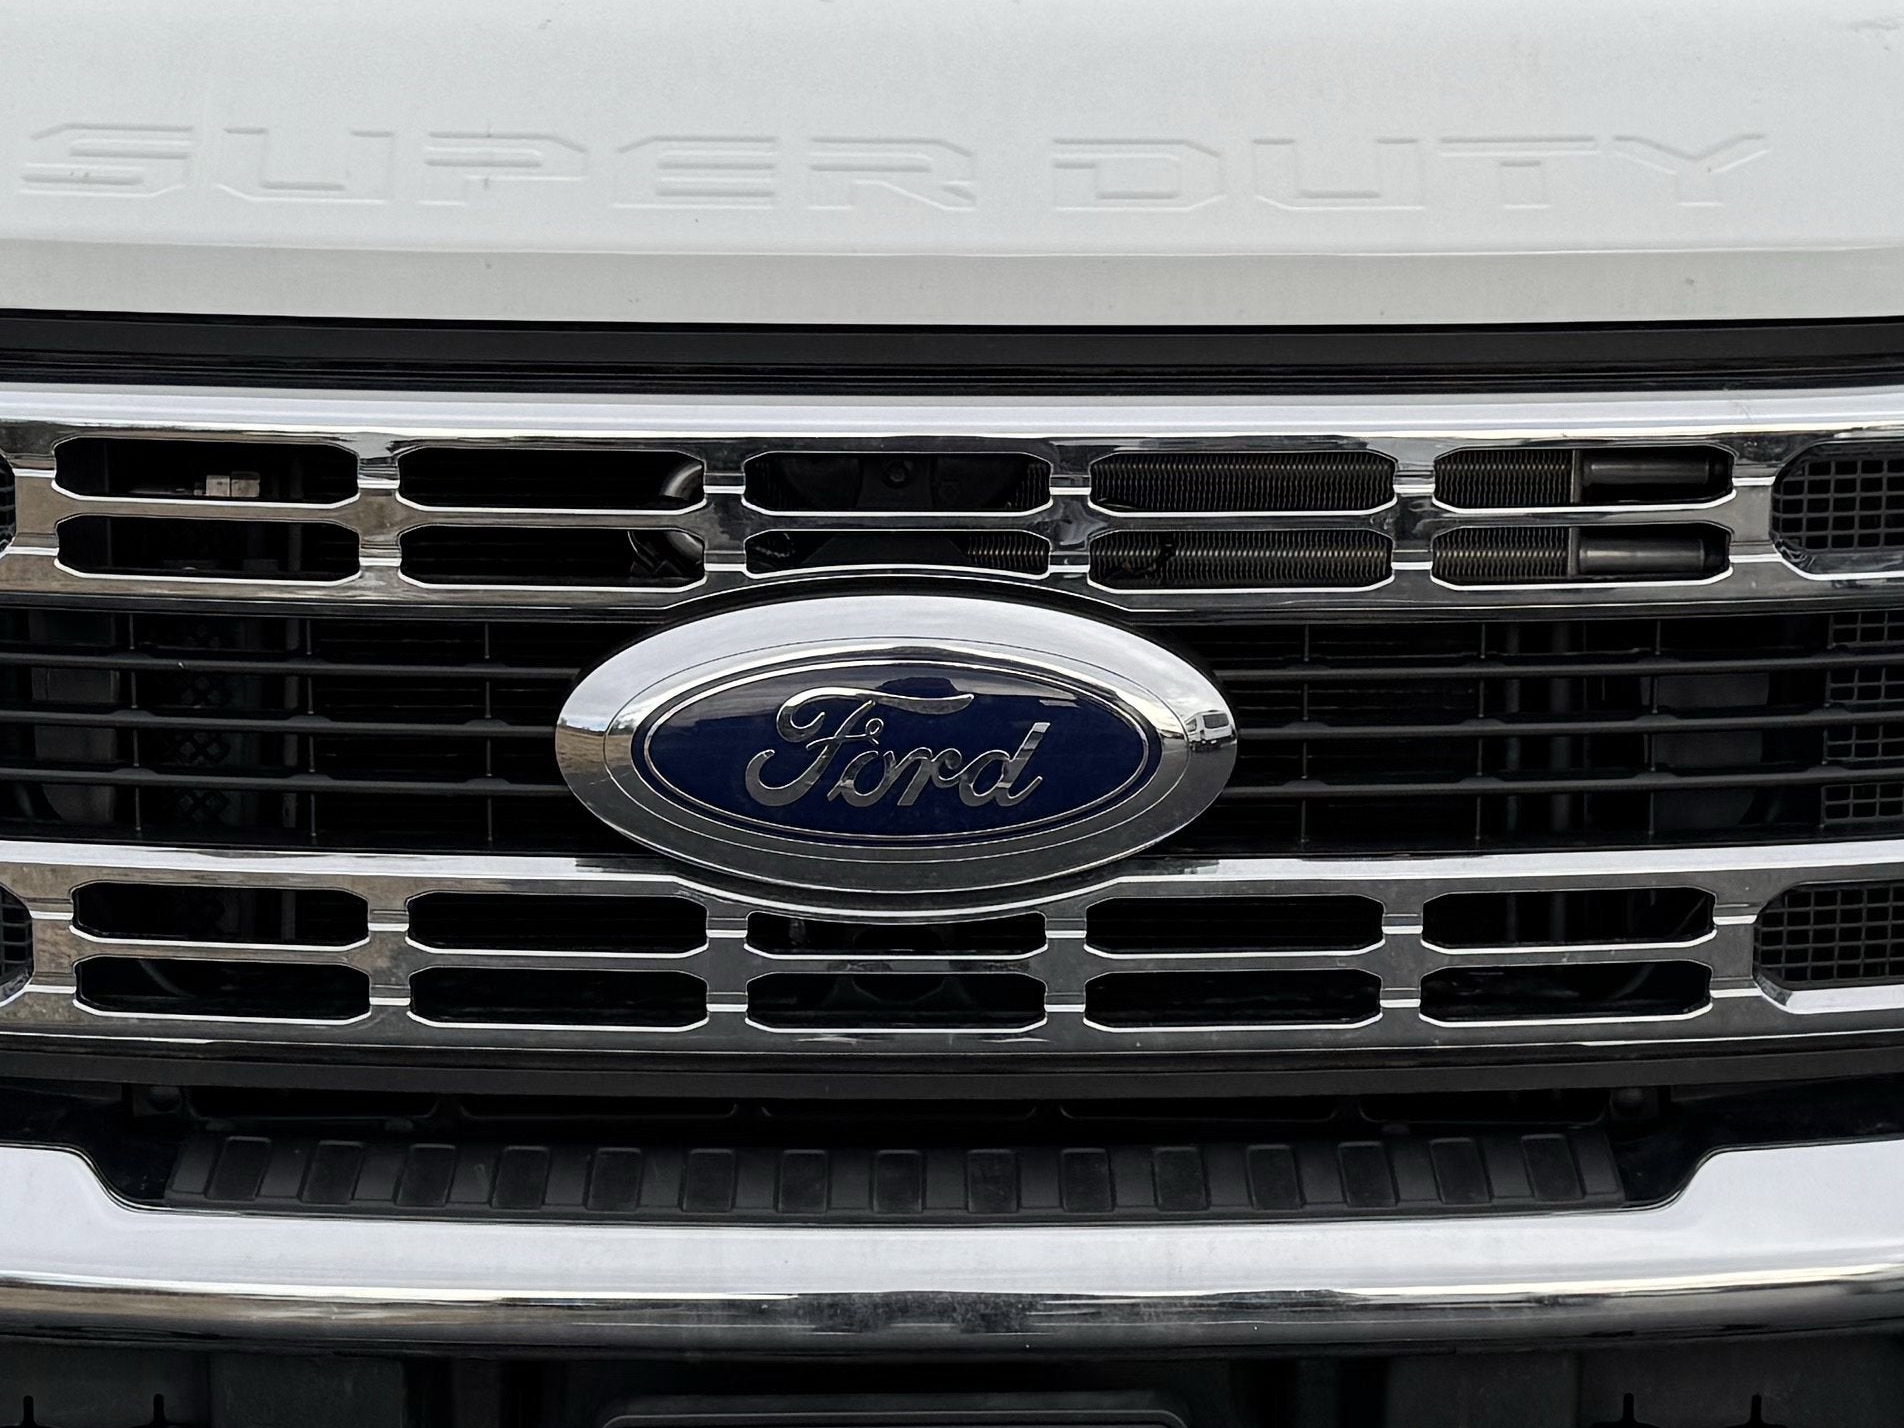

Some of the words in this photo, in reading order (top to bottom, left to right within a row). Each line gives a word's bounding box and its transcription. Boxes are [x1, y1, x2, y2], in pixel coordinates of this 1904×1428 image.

[17, 123, 978, 212] SUPER
[1050, 133, 1772, 212] DUTY
[744, 685, 1048, 809] Ford
